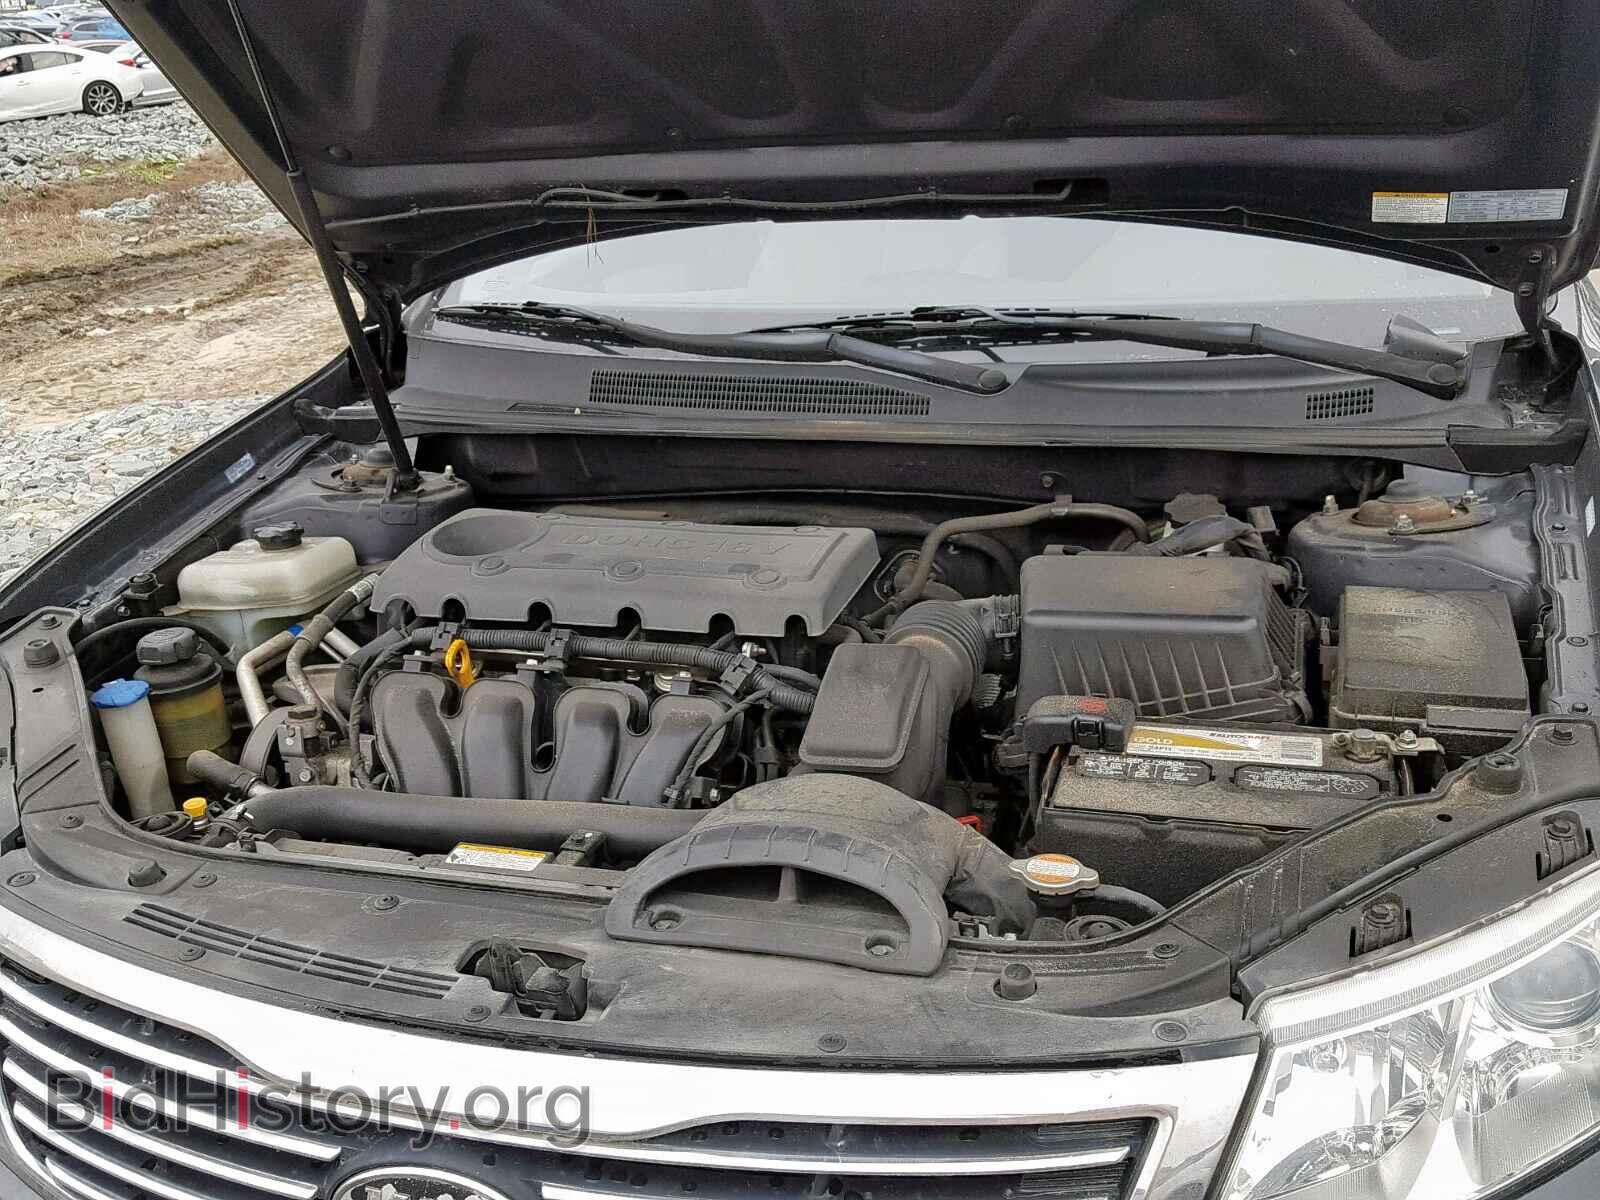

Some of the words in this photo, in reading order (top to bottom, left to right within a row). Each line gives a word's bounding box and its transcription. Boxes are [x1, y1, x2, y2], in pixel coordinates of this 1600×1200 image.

[563, 531, 696, 552] DOHC
[703, 536, 793, 556] 16V
[1134, 736, 1174, 745] GOLD
